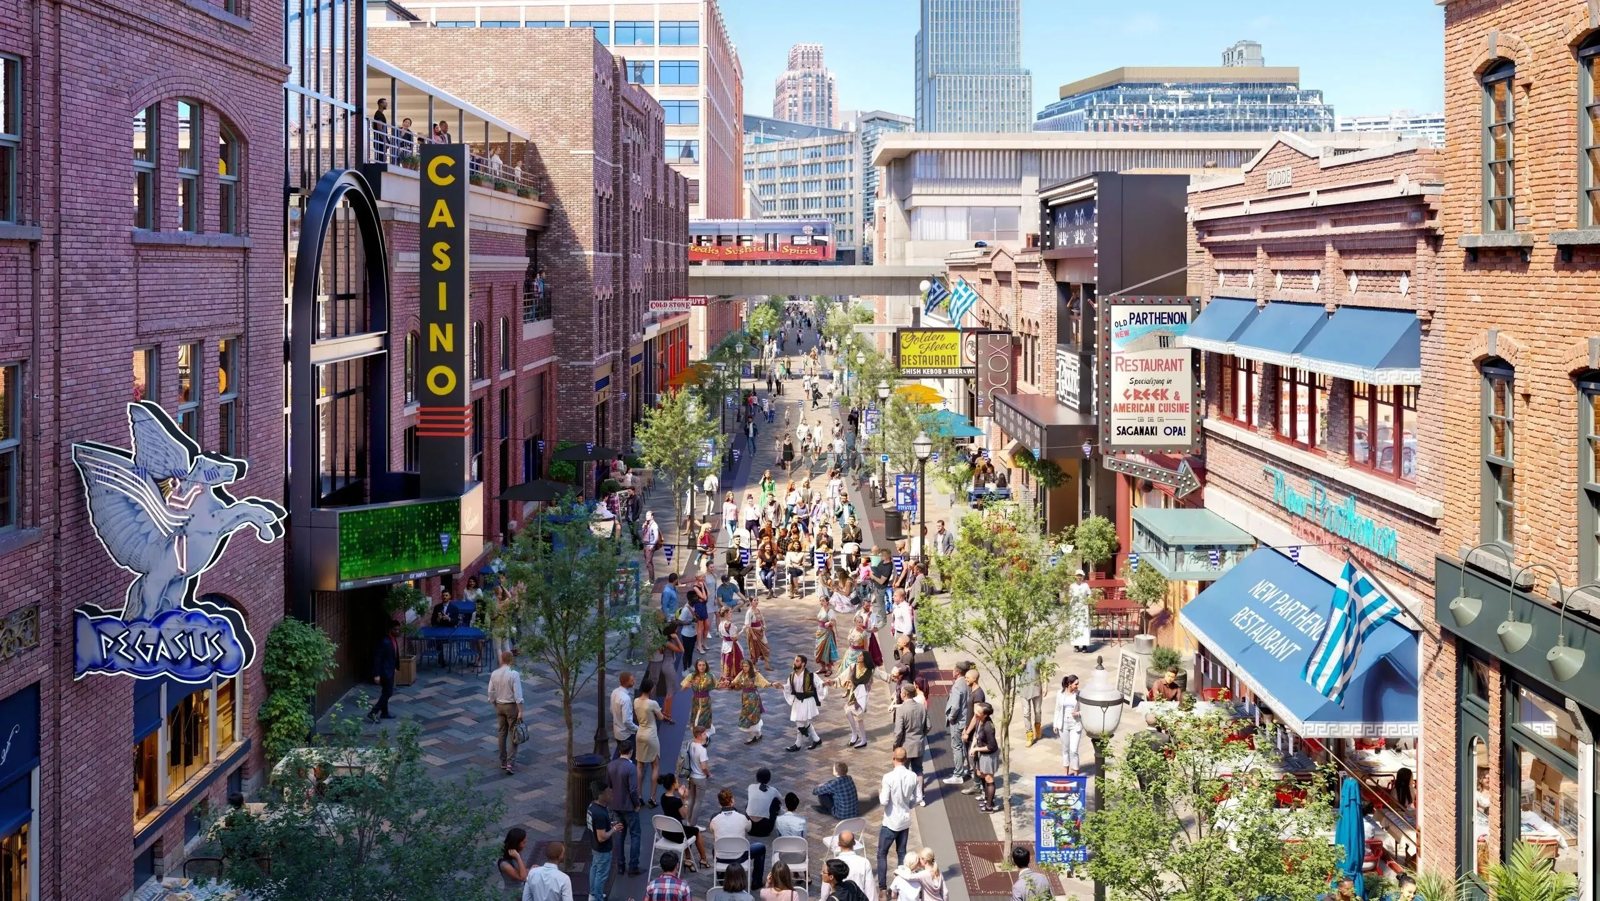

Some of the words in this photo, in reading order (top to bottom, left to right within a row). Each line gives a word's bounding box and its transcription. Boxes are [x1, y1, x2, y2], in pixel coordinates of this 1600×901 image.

[689, 244, 719, 255] teaks
[782, 245, 818, 255] Spirits
[426, 155, 457, 396] CASINO
[1114, 319, 1128, 328] OLD
[1129, 311, 1187, 325] PARTHENON
[1114, 329, 1130, 338] NEW
[901, 331, 946, 350] Golden
[919, 341, 958, 354] Fleece
[901, 354, 957, 366] RESTAURANT
[1129, 377, 1165, 386] Specializing
[1122, 388, 1169, 401] GREEK
[1173, 391, 1181, 401] &
[1112, 403, 1155, 413] AMERICAN
[1158, 403, 1190, 413] CUISINE
[1116, 425, 1158, 436] SAGANAKI
[1163, 426, 1186, 436] OPA!
[1247, 579, 1282, 604] NEW
[1229, 606, 1302, 662] RESTAURANT
[100, 629, 226, 664] PEGASUS
